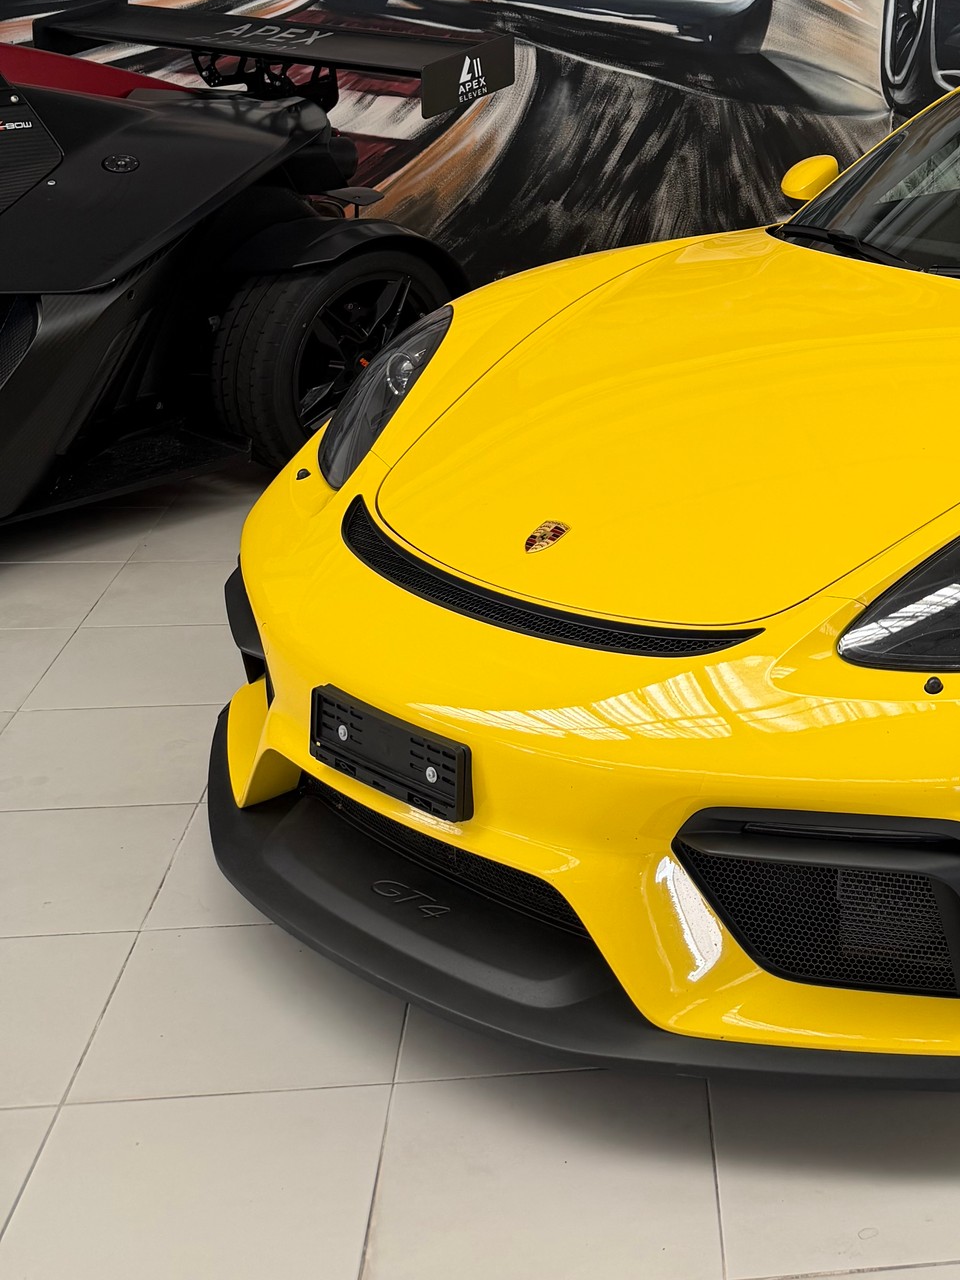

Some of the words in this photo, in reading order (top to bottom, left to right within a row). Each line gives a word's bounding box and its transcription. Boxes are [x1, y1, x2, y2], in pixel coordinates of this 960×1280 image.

[215, 23, 334, 45] APEX
[458, 76, 487, 95] APEX
[458, 87, 488, 103] ELEVEN
[372, 880, 451, 918] GT4
